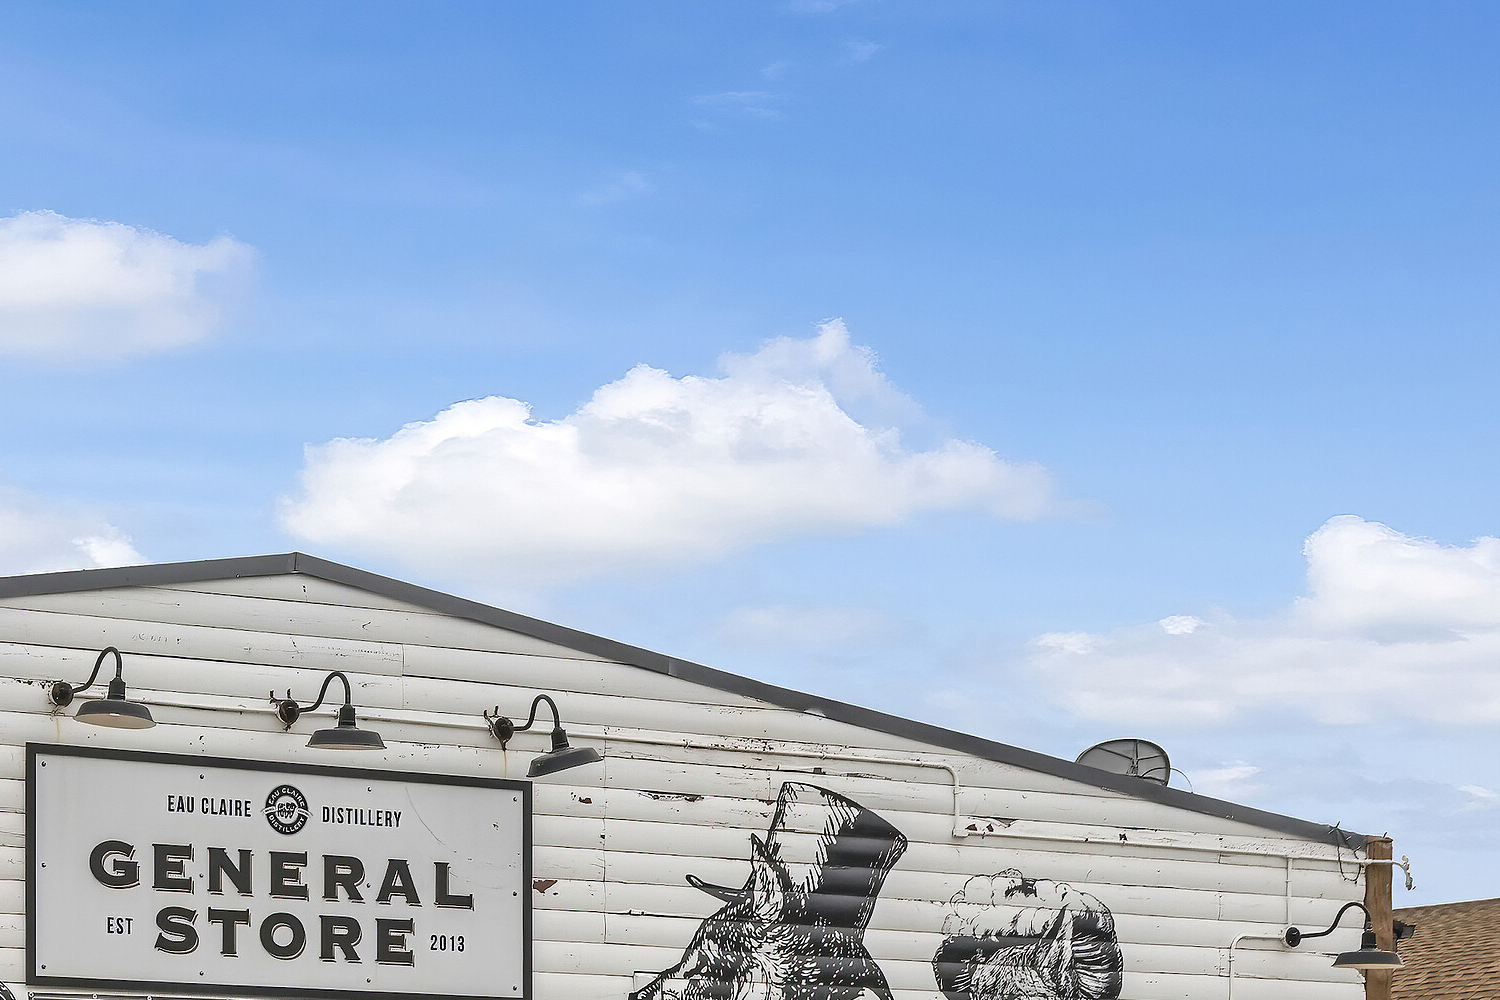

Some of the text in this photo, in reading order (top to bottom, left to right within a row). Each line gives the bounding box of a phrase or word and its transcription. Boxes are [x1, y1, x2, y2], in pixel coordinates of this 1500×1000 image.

[167, 794, 252, 818] EAU CLAIRE
[322, 806, 402, 828] DISTILLERY
[89, 839, 475, 910] GENERAL
[106, 917, 134, 935] EST
[153, 906, 415, 967] STORE
[430, 933, 465, 952] 2013
